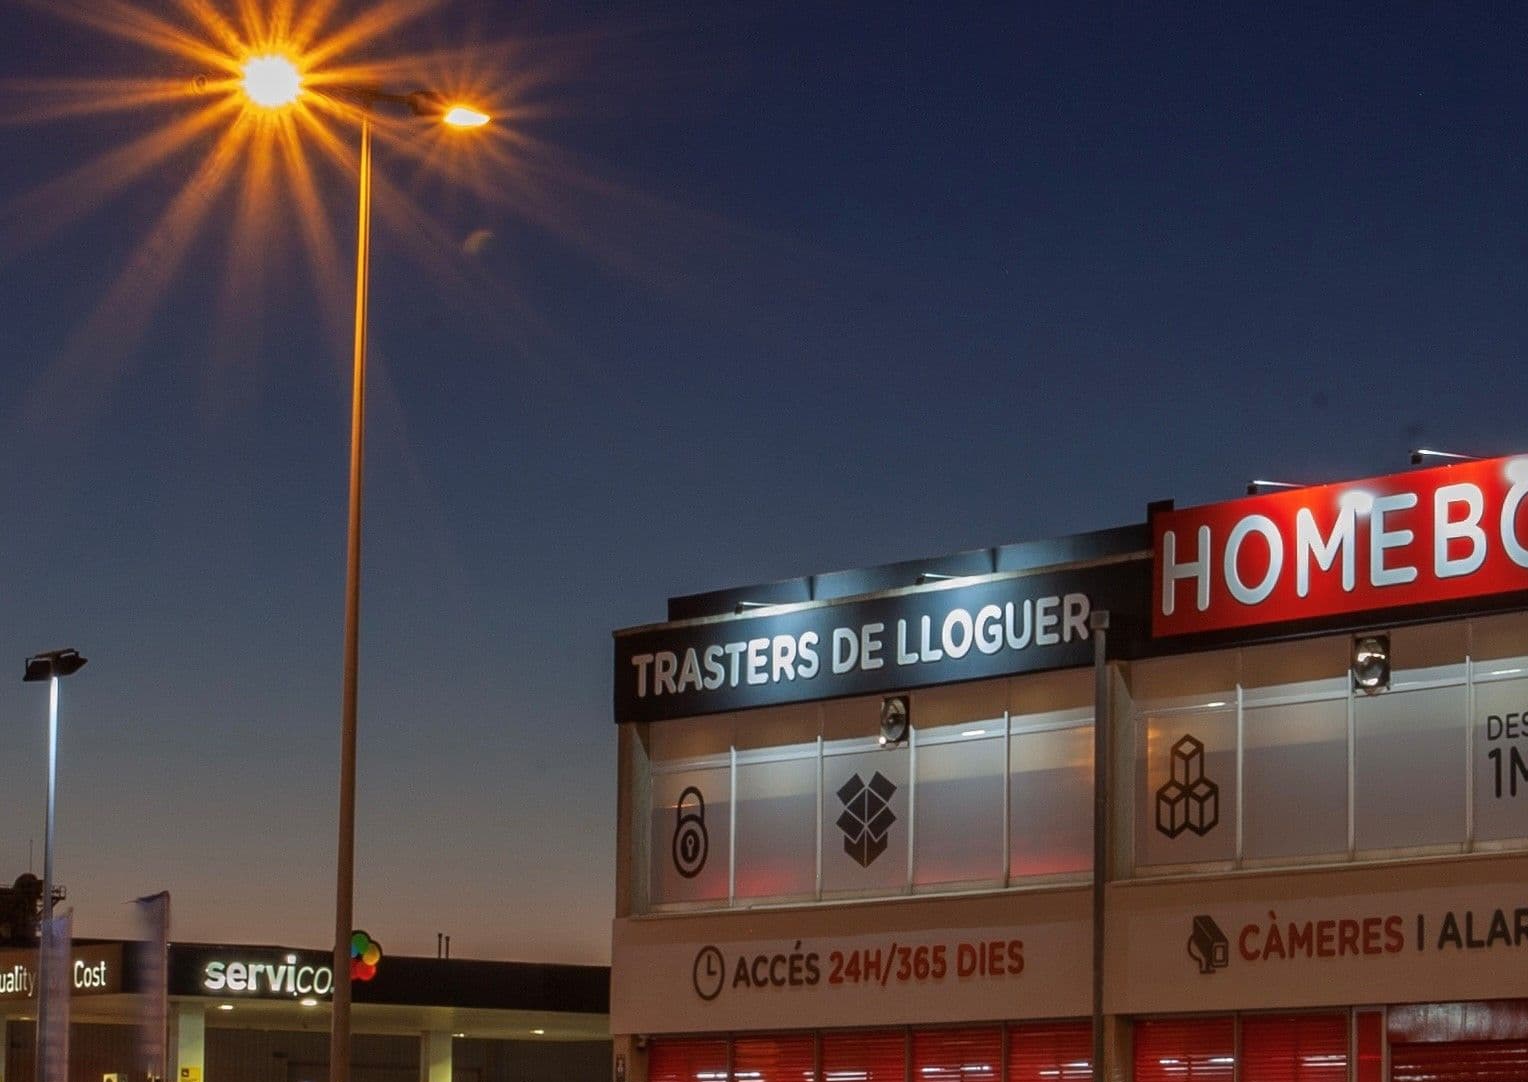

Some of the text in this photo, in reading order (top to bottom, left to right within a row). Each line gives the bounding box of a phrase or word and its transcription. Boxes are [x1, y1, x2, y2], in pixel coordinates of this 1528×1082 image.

[631, 592, 1092, 698] TRASTERS DE LLOGUER
[1238, 910, 1405, 961] CÀMERES
[1417, 913, 1424, 951] I
[73, 960, 107, 988] Cost
[732, 939, 1025, 989] ACCÉS 24H/365 DIES
